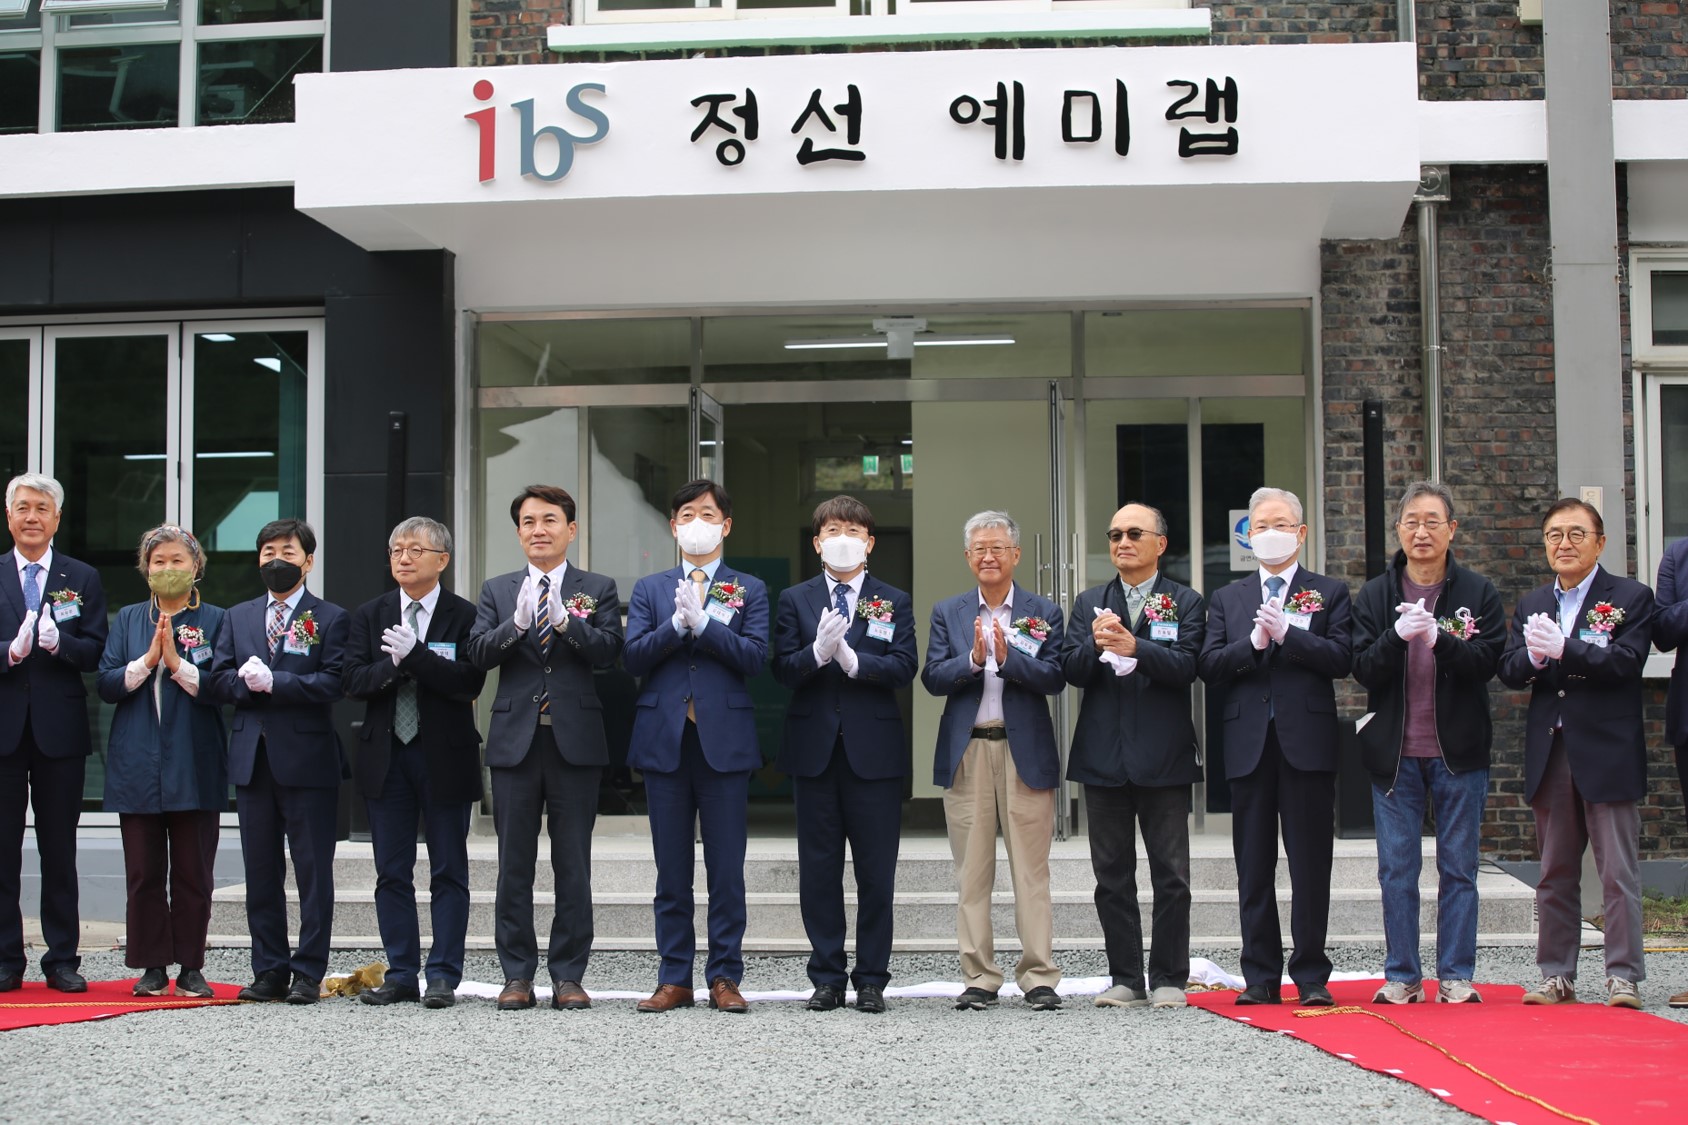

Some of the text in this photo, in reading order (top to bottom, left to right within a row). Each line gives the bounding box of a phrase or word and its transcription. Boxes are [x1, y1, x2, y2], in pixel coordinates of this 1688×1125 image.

[464, 79, 610, 183] ibs
[690, 76, 1239, 167] 정선 예미랩
